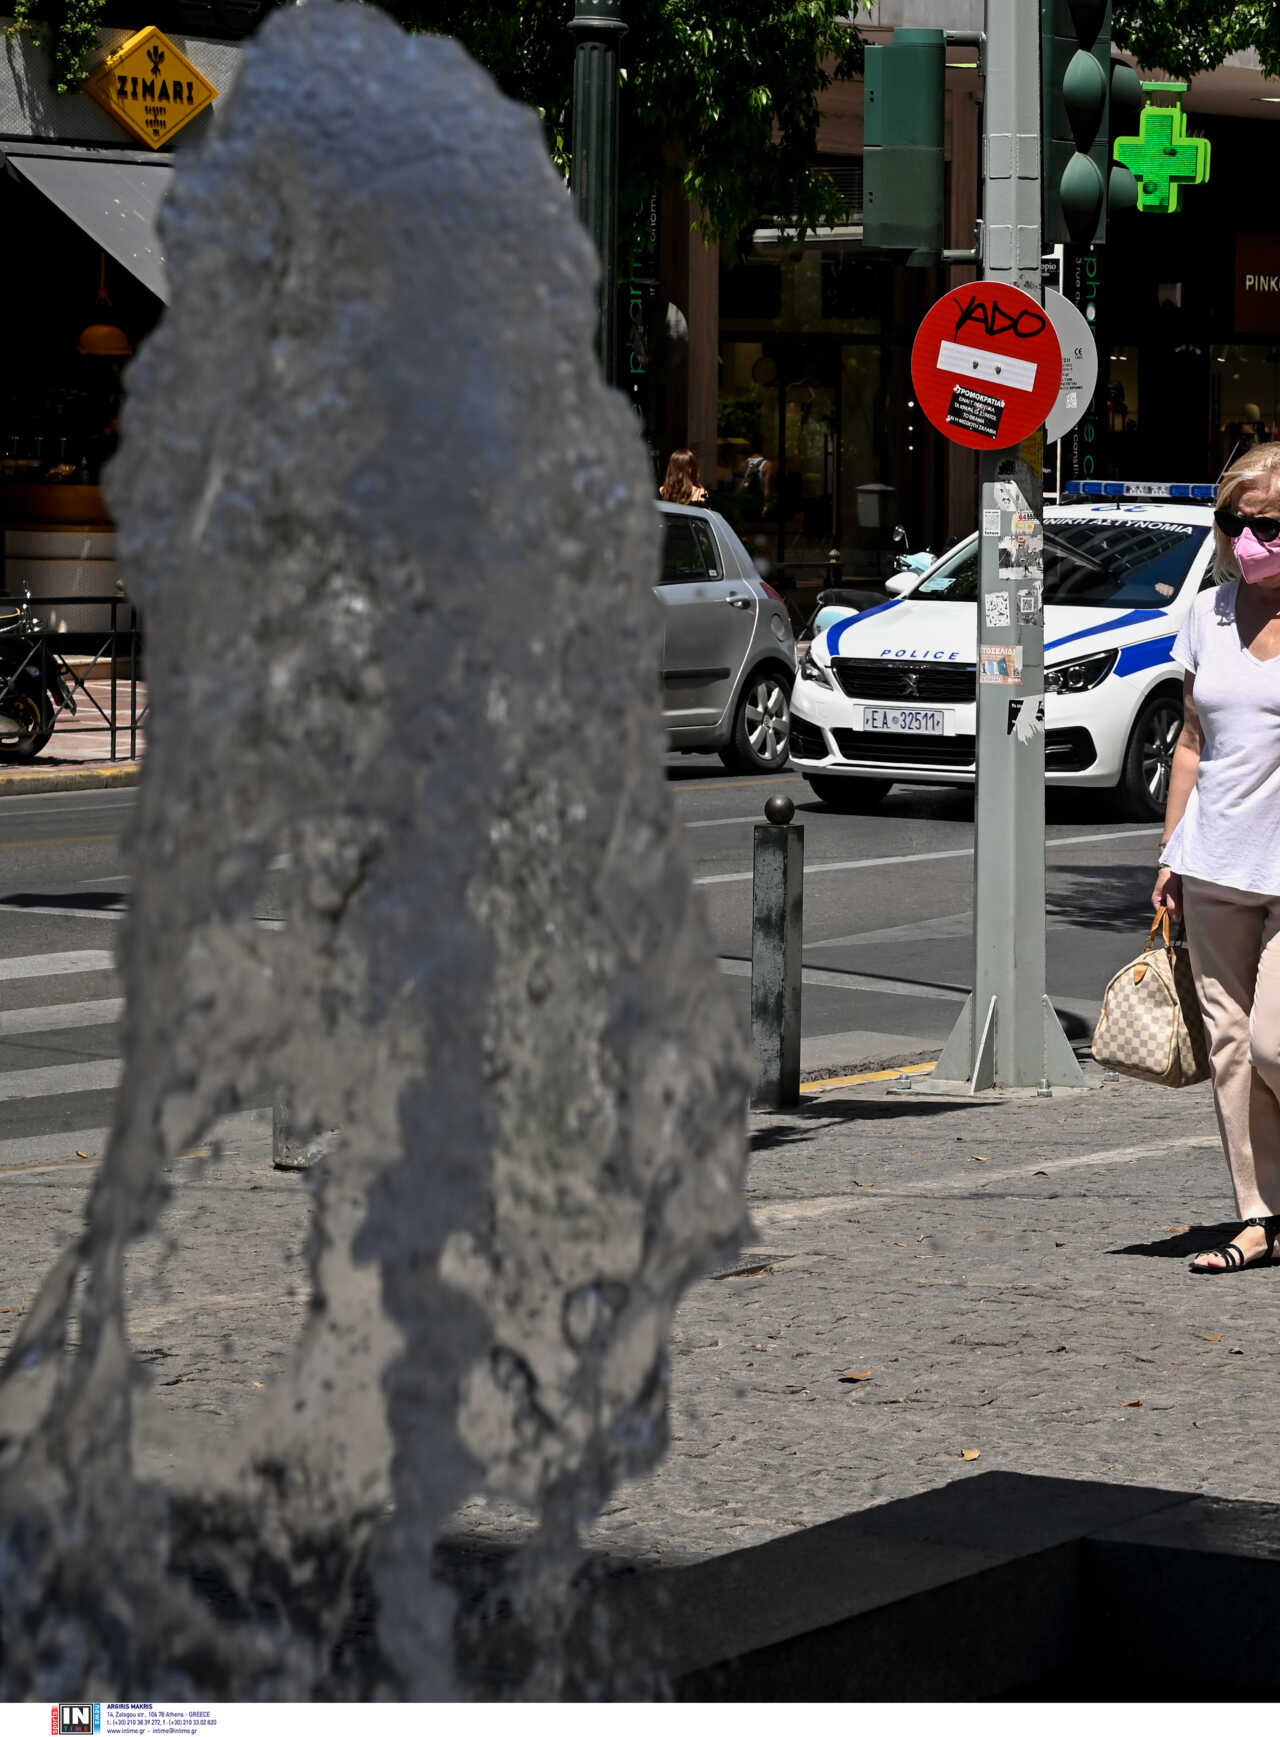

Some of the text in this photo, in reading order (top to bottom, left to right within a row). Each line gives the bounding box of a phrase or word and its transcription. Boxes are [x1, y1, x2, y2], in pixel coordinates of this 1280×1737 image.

[117, 75, 195, 105] ZIMARI
[1090, 518, 1194, 535] ΑΣΤΥΝΟΜΙΑ
[880, 649, 960, 660] POLICE
[899, 711, 936, 731] 32511
